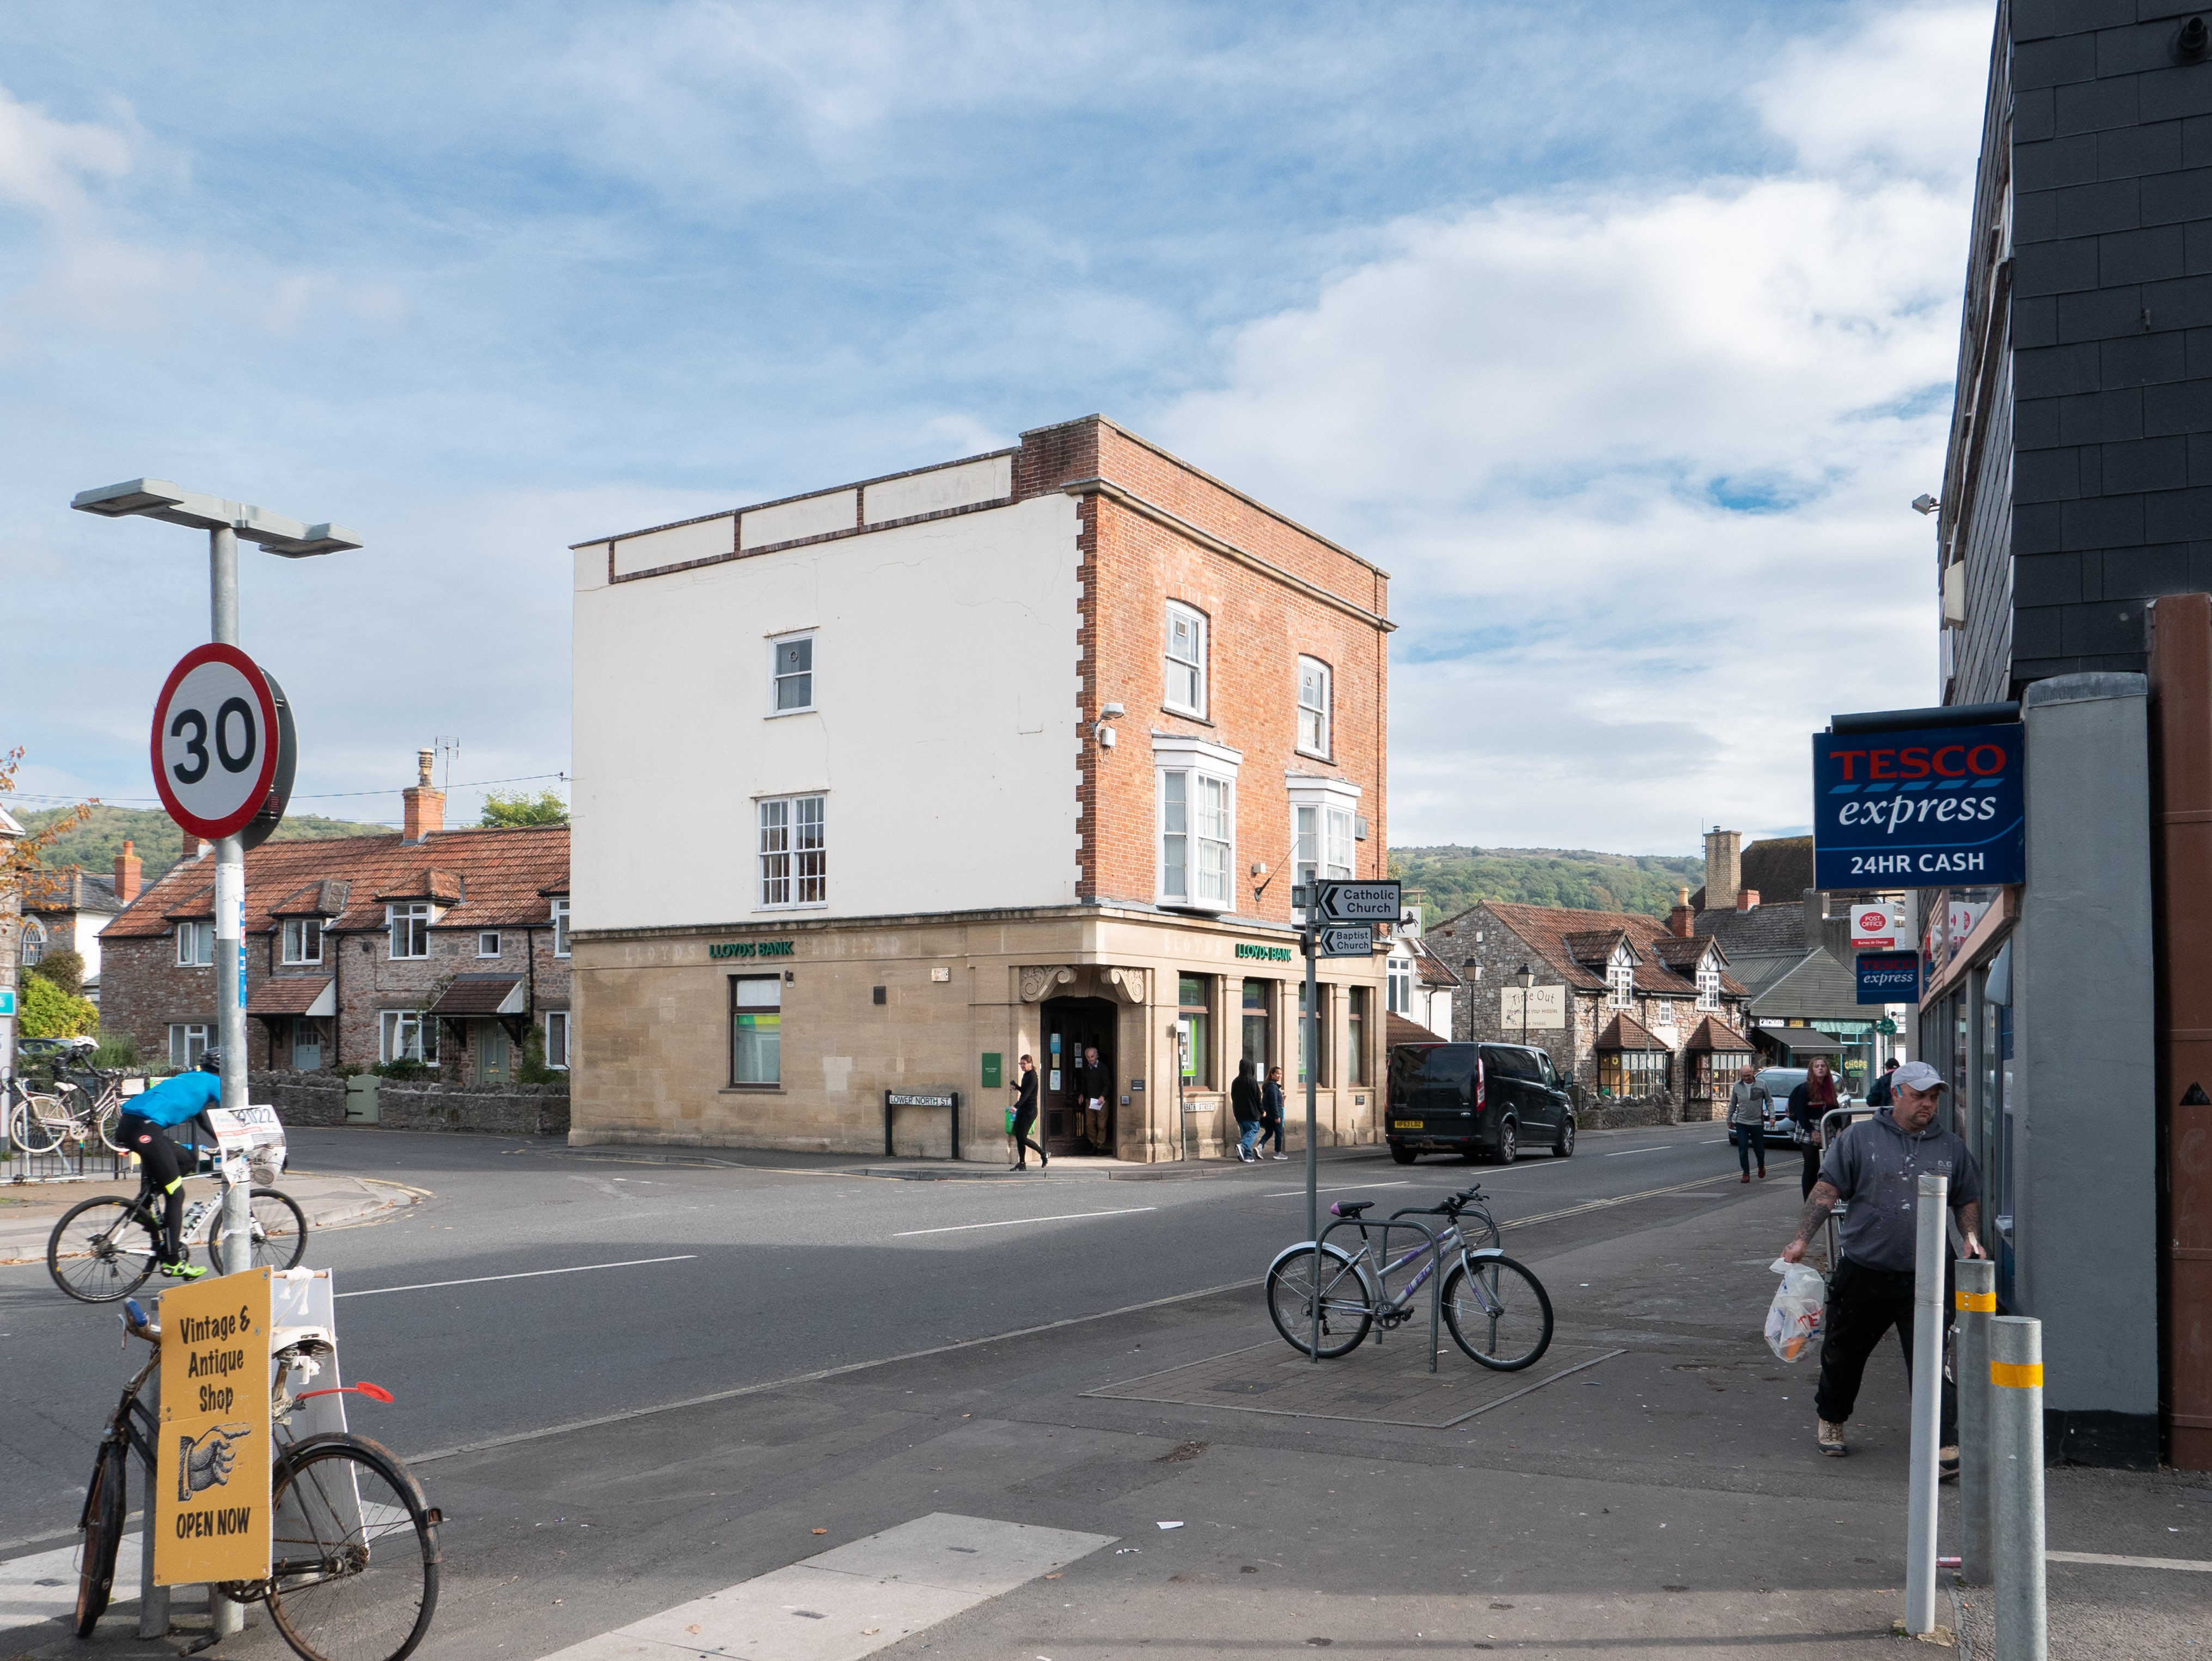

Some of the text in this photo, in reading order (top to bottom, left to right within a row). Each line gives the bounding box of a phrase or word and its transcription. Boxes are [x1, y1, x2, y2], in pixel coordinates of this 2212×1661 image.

[172, 697, 256, 784] 30
[1829, 744, 2006, 780] TESCO
[1838, 795, 1996, 834] express
[1851, 853, 1984, 874] 24HR CASH
[1344, 889, 1394, 900] Catholic
[1347, 903, 1390, 913] Church
[1337, 932, 1368, 941] Baptist
[709, 941, 794, 958] LLOYDS BANK
[1236, 943, 1292, 962] LLOYDS BANK
[1861, 958, 1916, 970] TESCO
[1863, 974, 1914, 986] express
[1537, 990, 1555, 1004] Out
[1844, 1060, 1867, 1070] CHOPS
[890, 1096, 913, 1104] LOWER
[915, 1097, 938, 1105] NORTH
[1199, 1102, 1214, 1110] STREET
[180, 1305, 250, 1345] Vintage &
[188, 1349, 243, 1378] Antique
[199, 1383, 234, 1415] Shop
[176, 1506, 250, 1539] OPEN NOW
